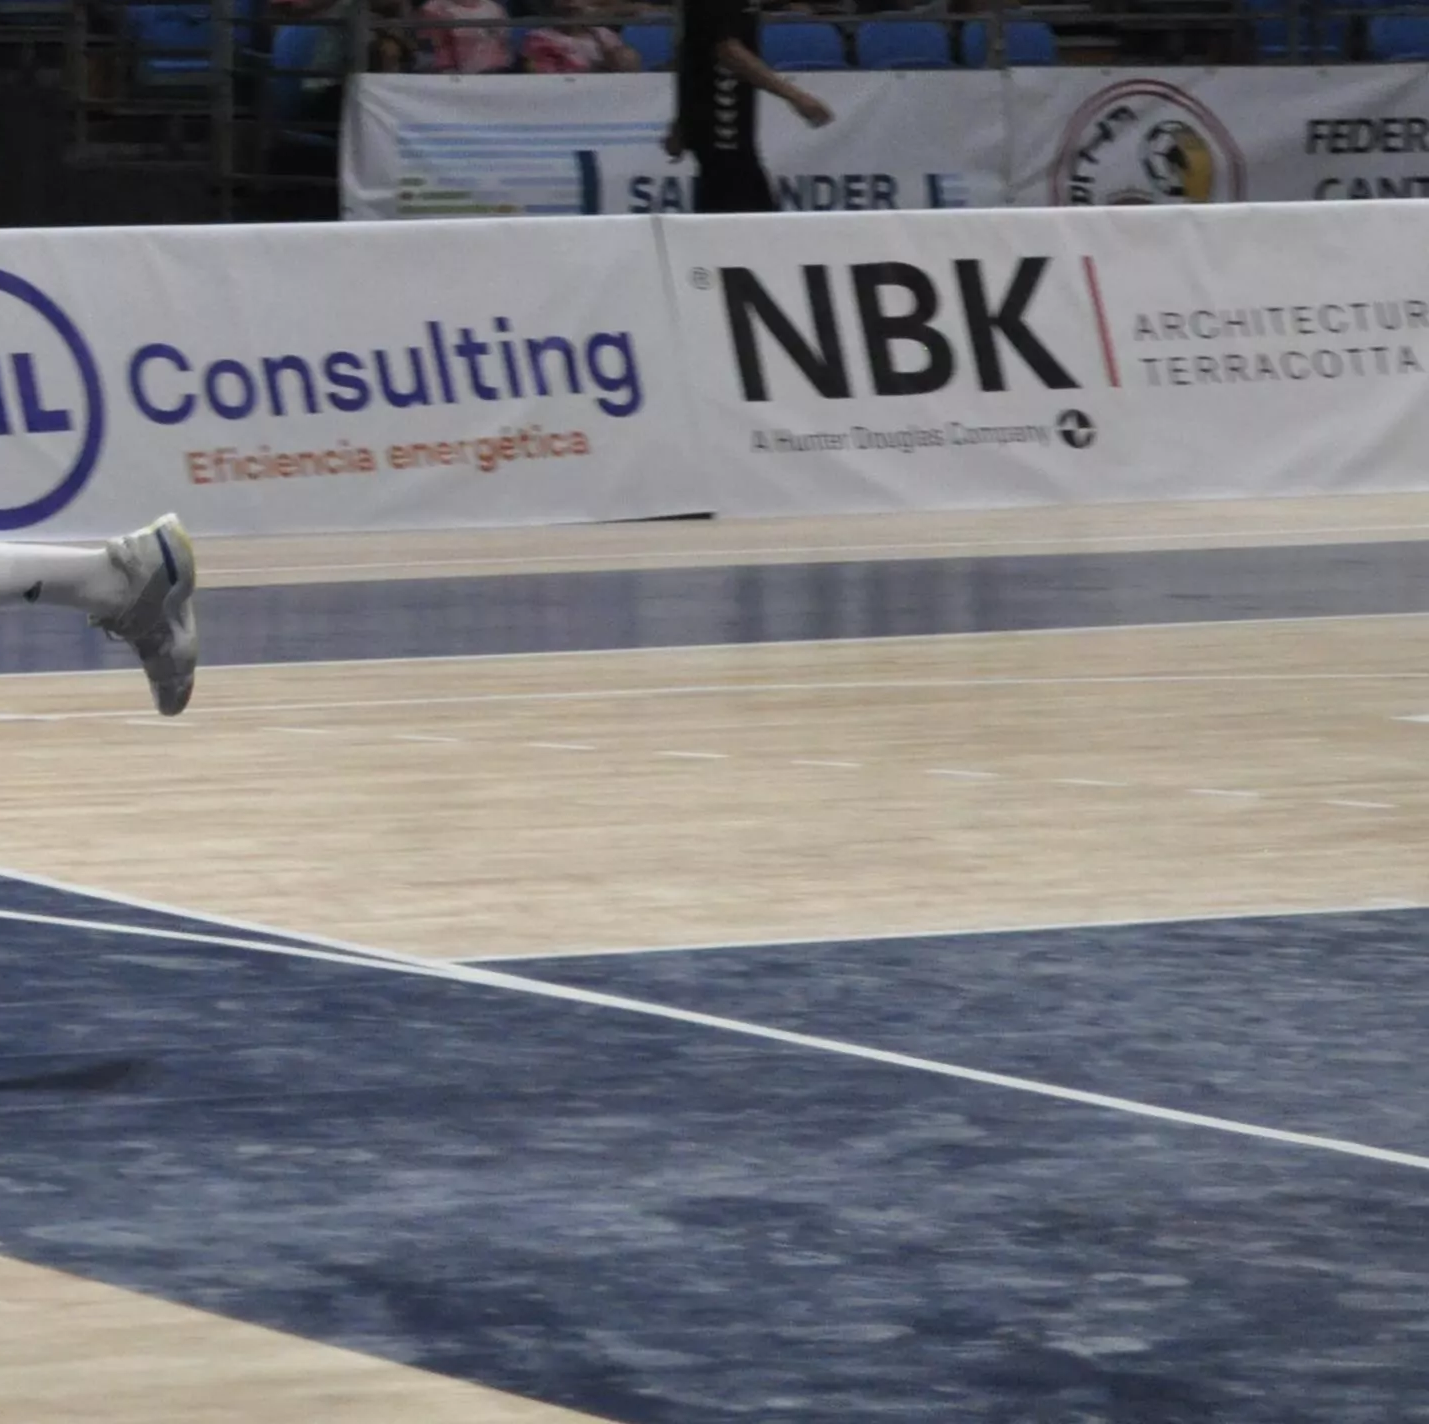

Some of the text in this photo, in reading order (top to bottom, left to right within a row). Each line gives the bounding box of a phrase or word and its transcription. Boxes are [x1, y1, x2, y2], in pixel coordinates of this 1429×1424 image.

[628, 174, 900, 213] SANDER
[718, 256, 1082, 402] NBK
[128, 316, 643, 424] Consulting
[1139, 345, 1426, 388] TERRACOTTA
[184, 425, 591, 486] Eficiencia energética
